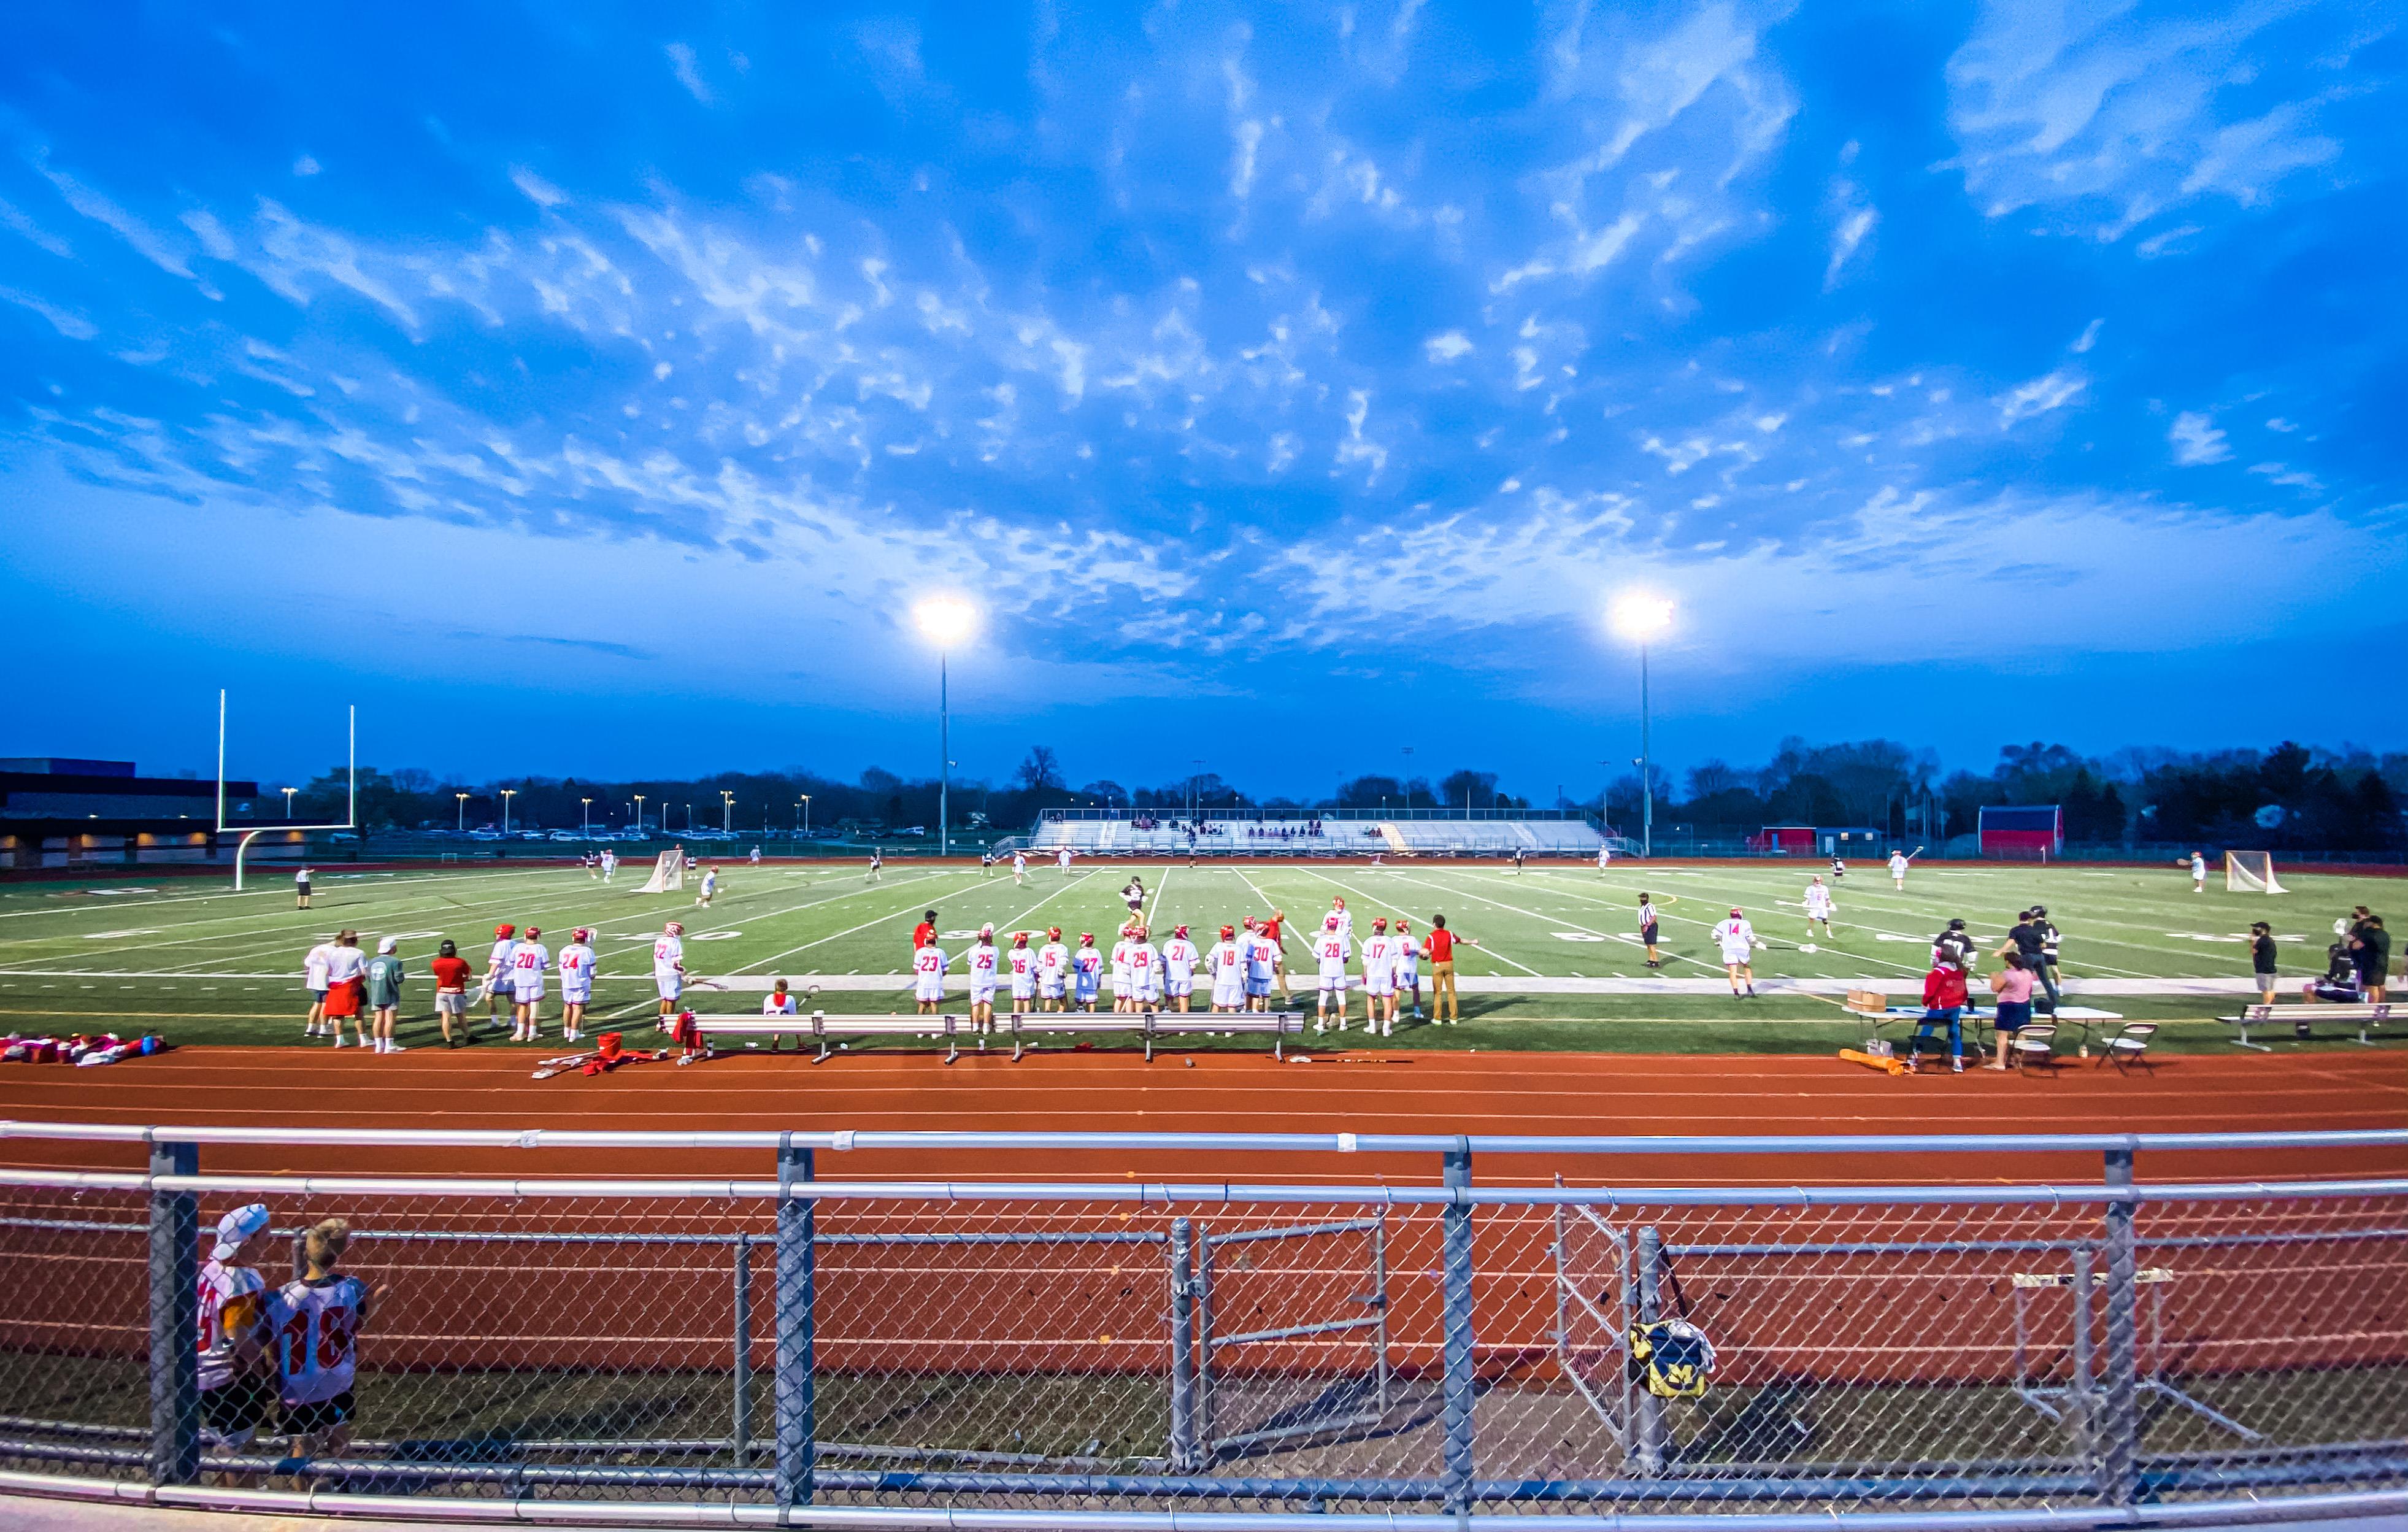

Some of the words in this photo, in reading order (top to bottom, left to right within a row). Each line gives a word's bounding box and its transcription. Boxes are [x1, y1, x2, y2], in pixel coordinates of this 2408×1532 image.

[1729, 923, 1739, 936] 14
[1172, 945, 1185, 961] 21
[1223, 950, 1235, 966] 18
[1253, 947, 1269, 962] 30
[1325, 942, 1340, 958] 28
[1372, 944, 1385, 959] 17
[517, 953, 536, 969] 20
[563, 953, 580, 969] 24
[921, 955, 939, 972] 23
[977, 954, 993, 969] 25
[1045, 952, 1056, 967] 15
[1082, 958, 1098, 972] 27
[1133, 952, 1148, 968] 29
[282, 1305, 349, 1376] 18
[1668, 1363, 1693, 1384] M
